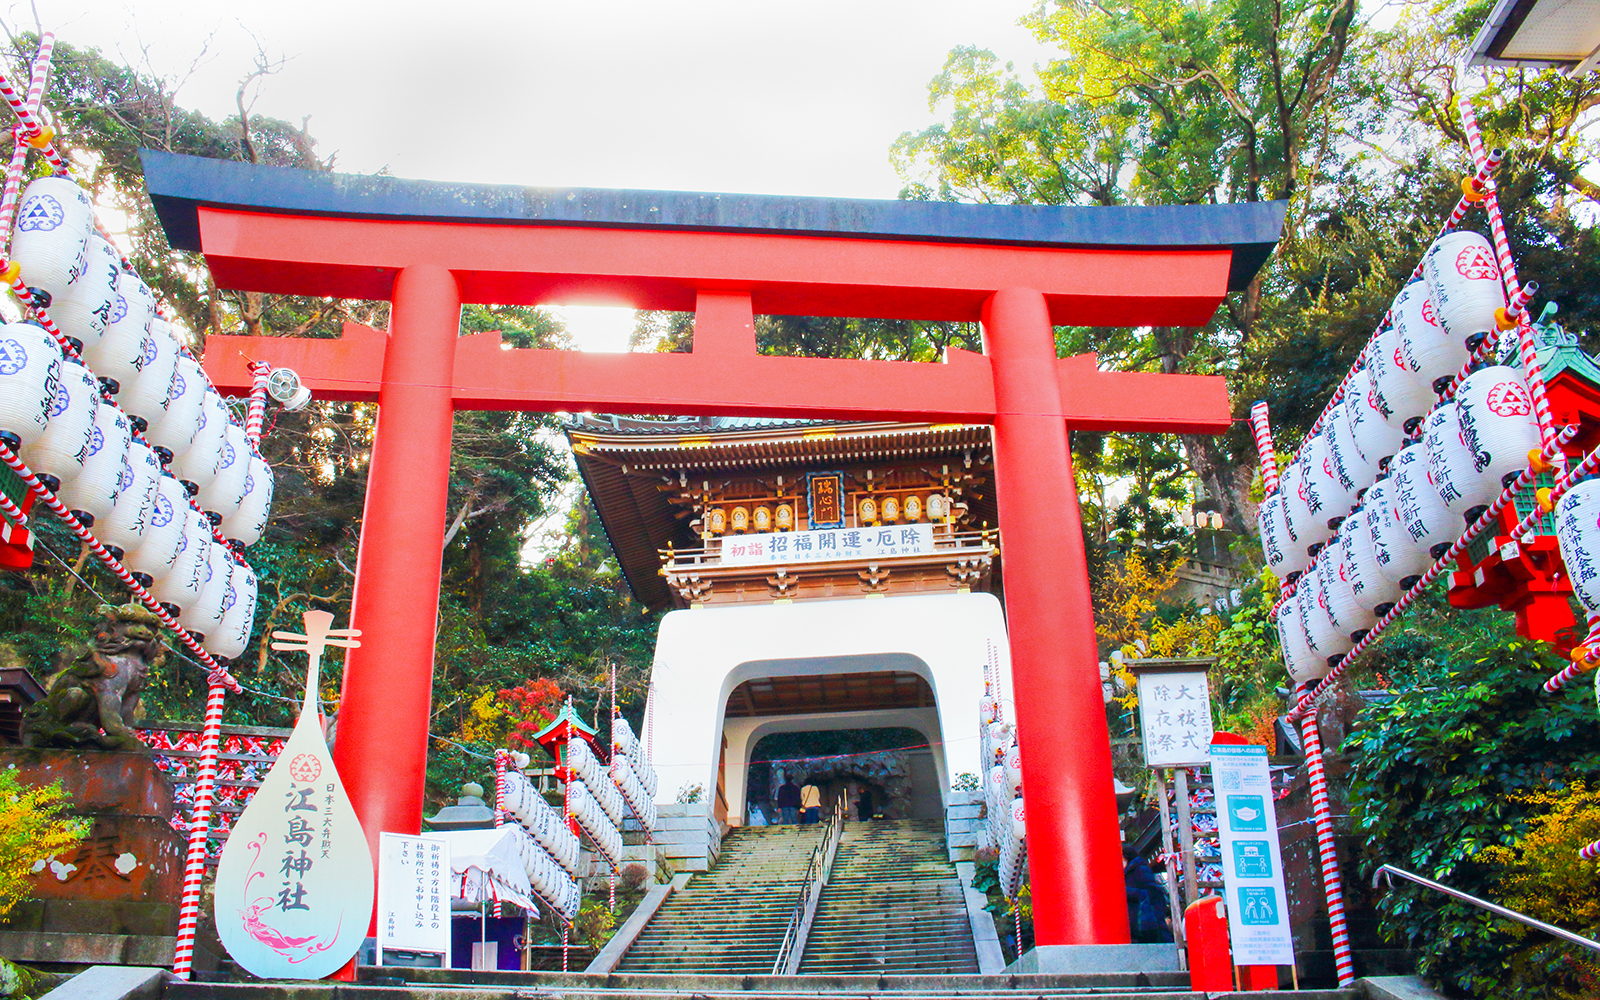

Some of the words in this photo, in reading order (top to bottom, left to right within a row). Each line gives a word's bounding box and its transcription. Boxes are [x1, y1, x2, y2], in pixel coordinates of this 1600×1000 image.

[817, 480, 834, 520] 瑞心門
[1425, 432, 1462, 507] 東京新聞
[1366, 509, 1391, 568] 鶴屋八幡
[1393, 469, 1430, 543] 東京新聞
[730, 541, 764, 558] 初詣
[1565, 513, 1598, 584] 藤沢市民会館
[1153, 684, 1176, 752] 除夜祭
[1175, 684, 1199, 750] 大祓式
[275, 782, 319, 913] 江島神社
[320, 783, 336, 859] 日本三大弁財天
[400, 841, 410, 866] 下さい
[414, 843, 426, 929] 社務所にてお申し込み
[430, 843, 441, 930] 御祈祷の方は階段上の
[387, 910, 396, 938] 江島神社
